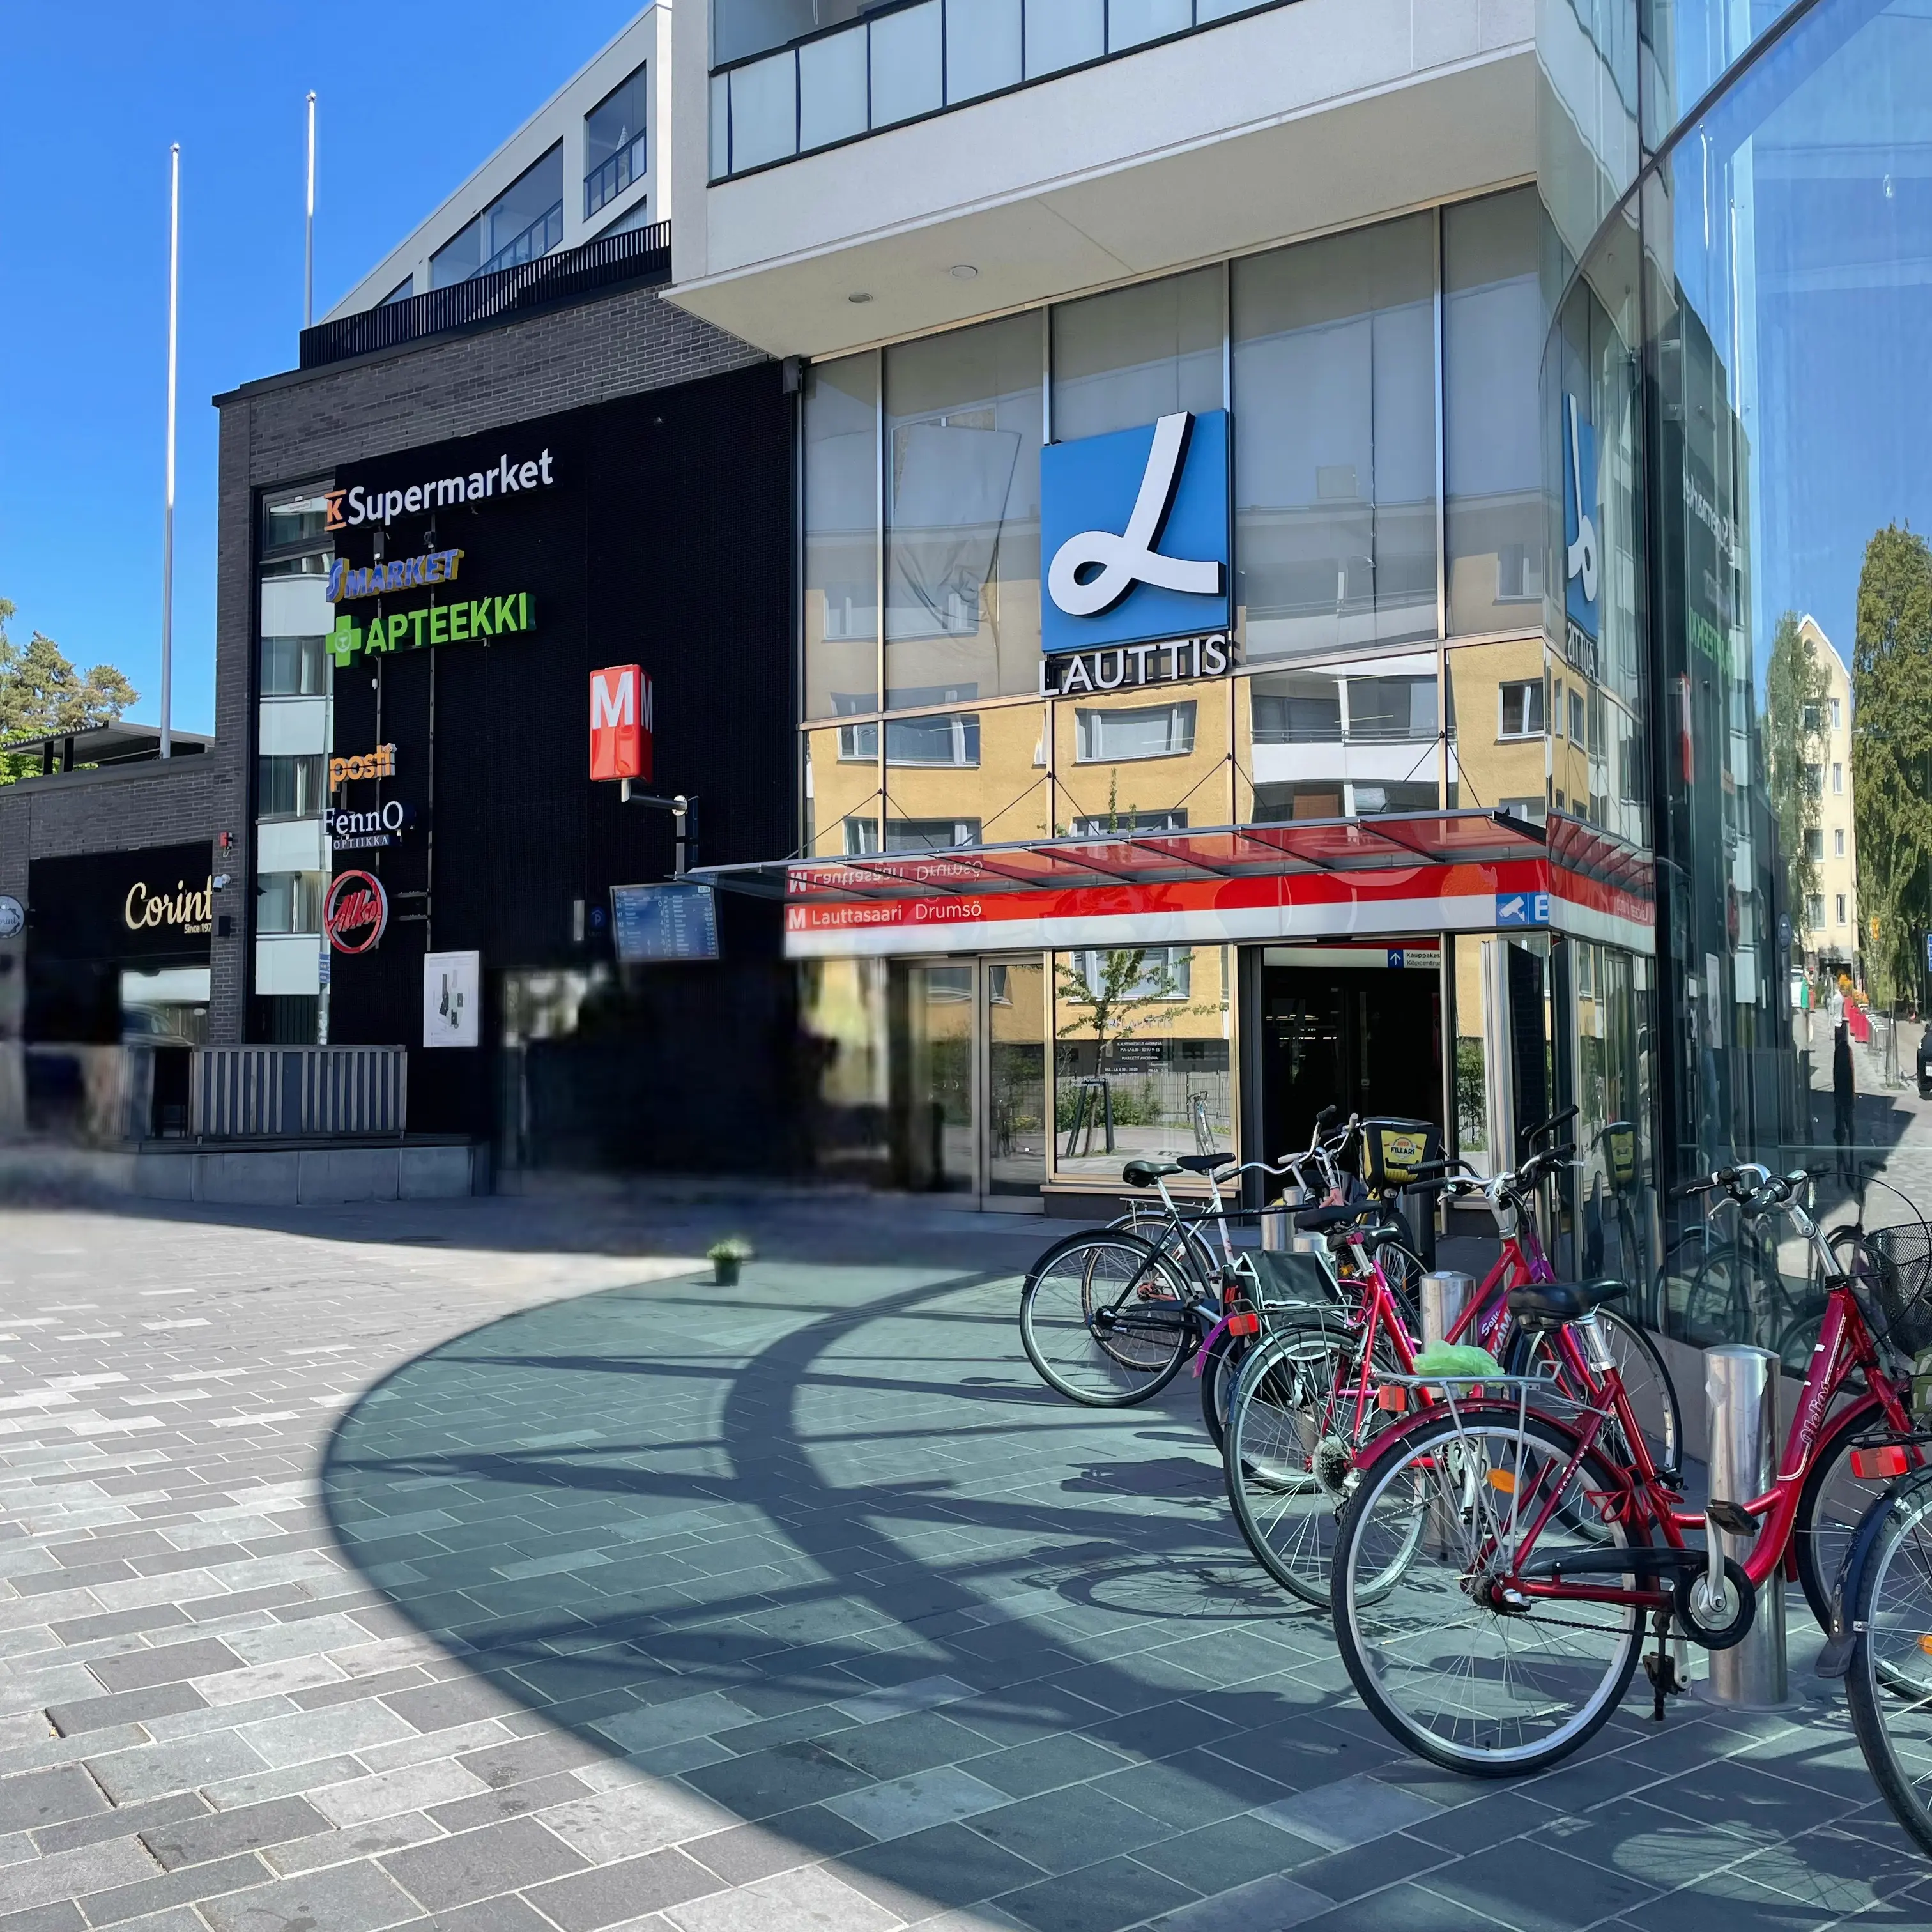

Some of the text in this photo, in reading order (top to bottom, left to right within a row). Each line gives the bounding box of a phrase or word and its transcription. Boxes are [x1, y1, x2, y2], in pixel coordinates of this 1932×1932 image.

[364, 592, 529, 654] APTEEKKI
[1039, 634, 1228, 696] LAUTTIS
[593, 671, 634, 730] M
[641, 672, 653, 733] M
[330, 744, 395, 792] posti
[334, 834, 388, 850] OPTIIKKA
[125, 875, 212, 930] Corint
[328, 889, 380, 932] Alko
[788, 901, 982, 930] M Lauttasaari Drumsö
[1535, 895, 1549, 921] E
[184, 924, 200, 933] Since
